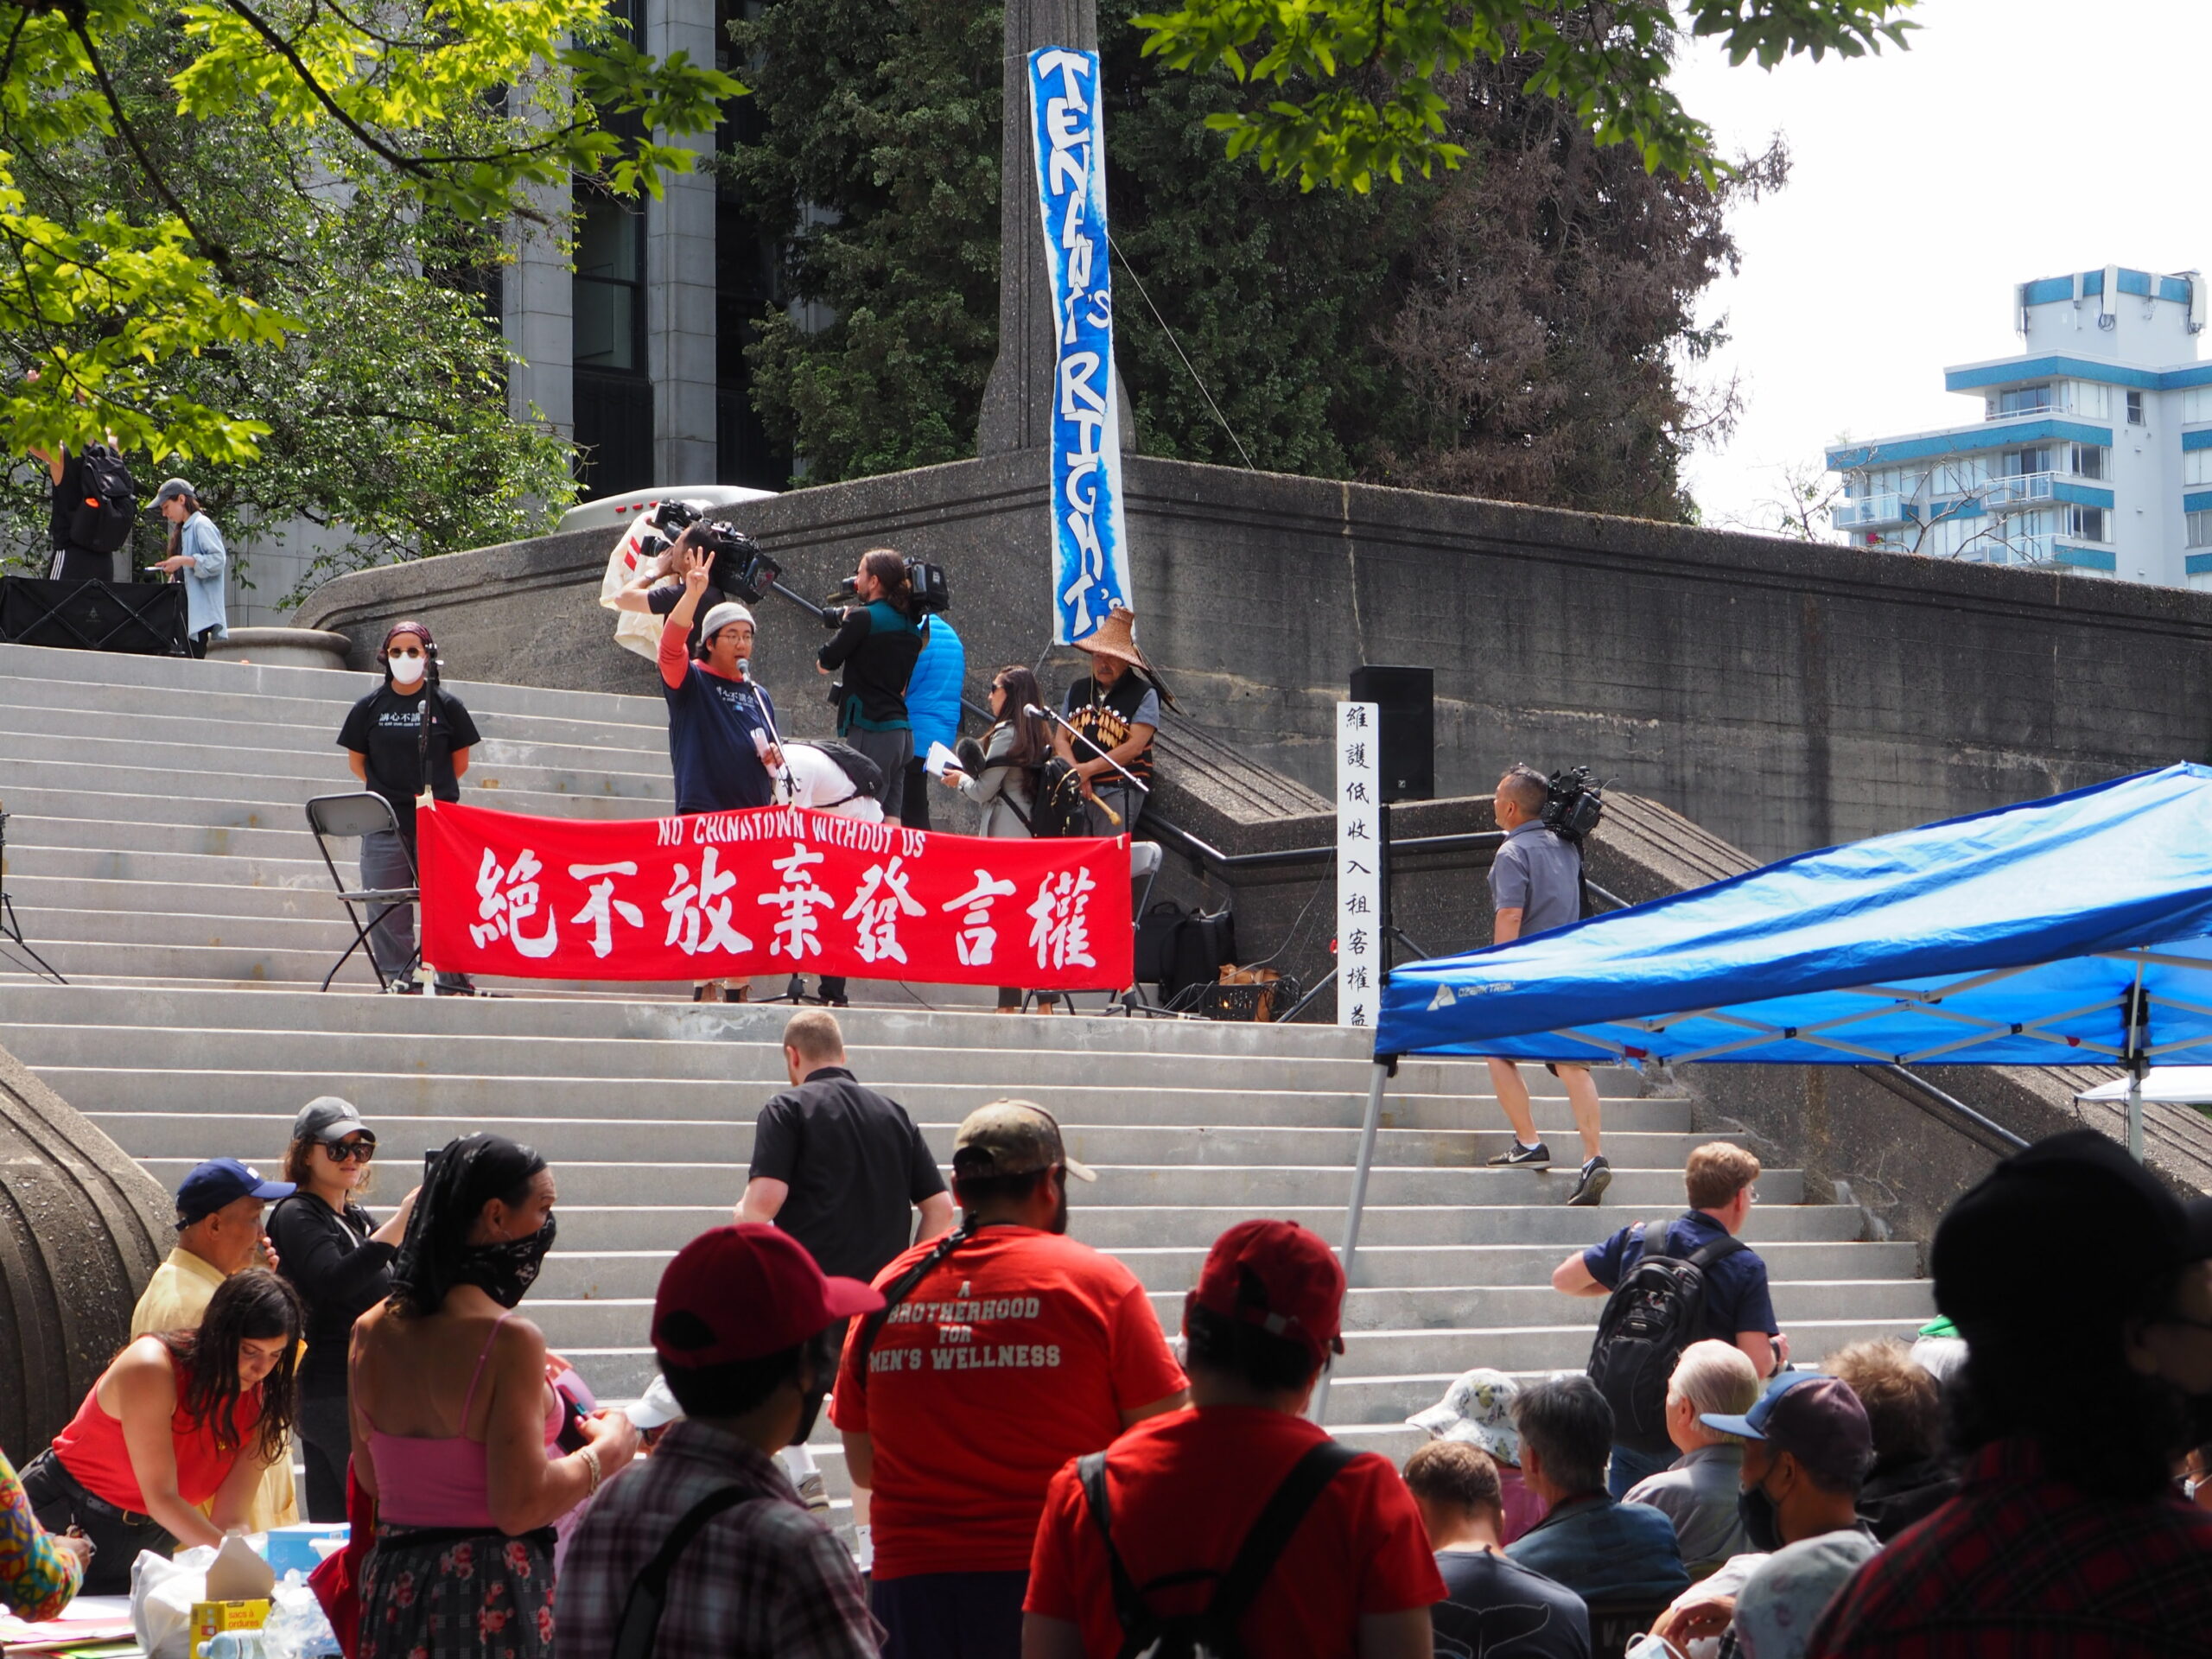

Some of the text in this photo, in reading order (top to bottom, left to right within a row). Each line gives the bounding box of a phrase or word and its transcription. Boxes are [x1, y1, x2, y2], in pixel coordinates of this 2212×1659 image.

[1037, 49, 1110, 345] TENANT'S
[657, 810, 925, 858] NO CHINATOWN WITHOUT US
[1344, 706, 1372, 1027] 維護低收入租客權益
[469, 842, 1096, 970] 絕不放棄發言權
[957, 1281, 971, 1297] A
[887, 1298, 1040, 1324] BROTHERHOOD
[939, 1325, 972, 1344] FOR
[869, 1344, 1061, 1372] MEN'S WELLNESS
[228, 1618, 259, 1628] ordures
